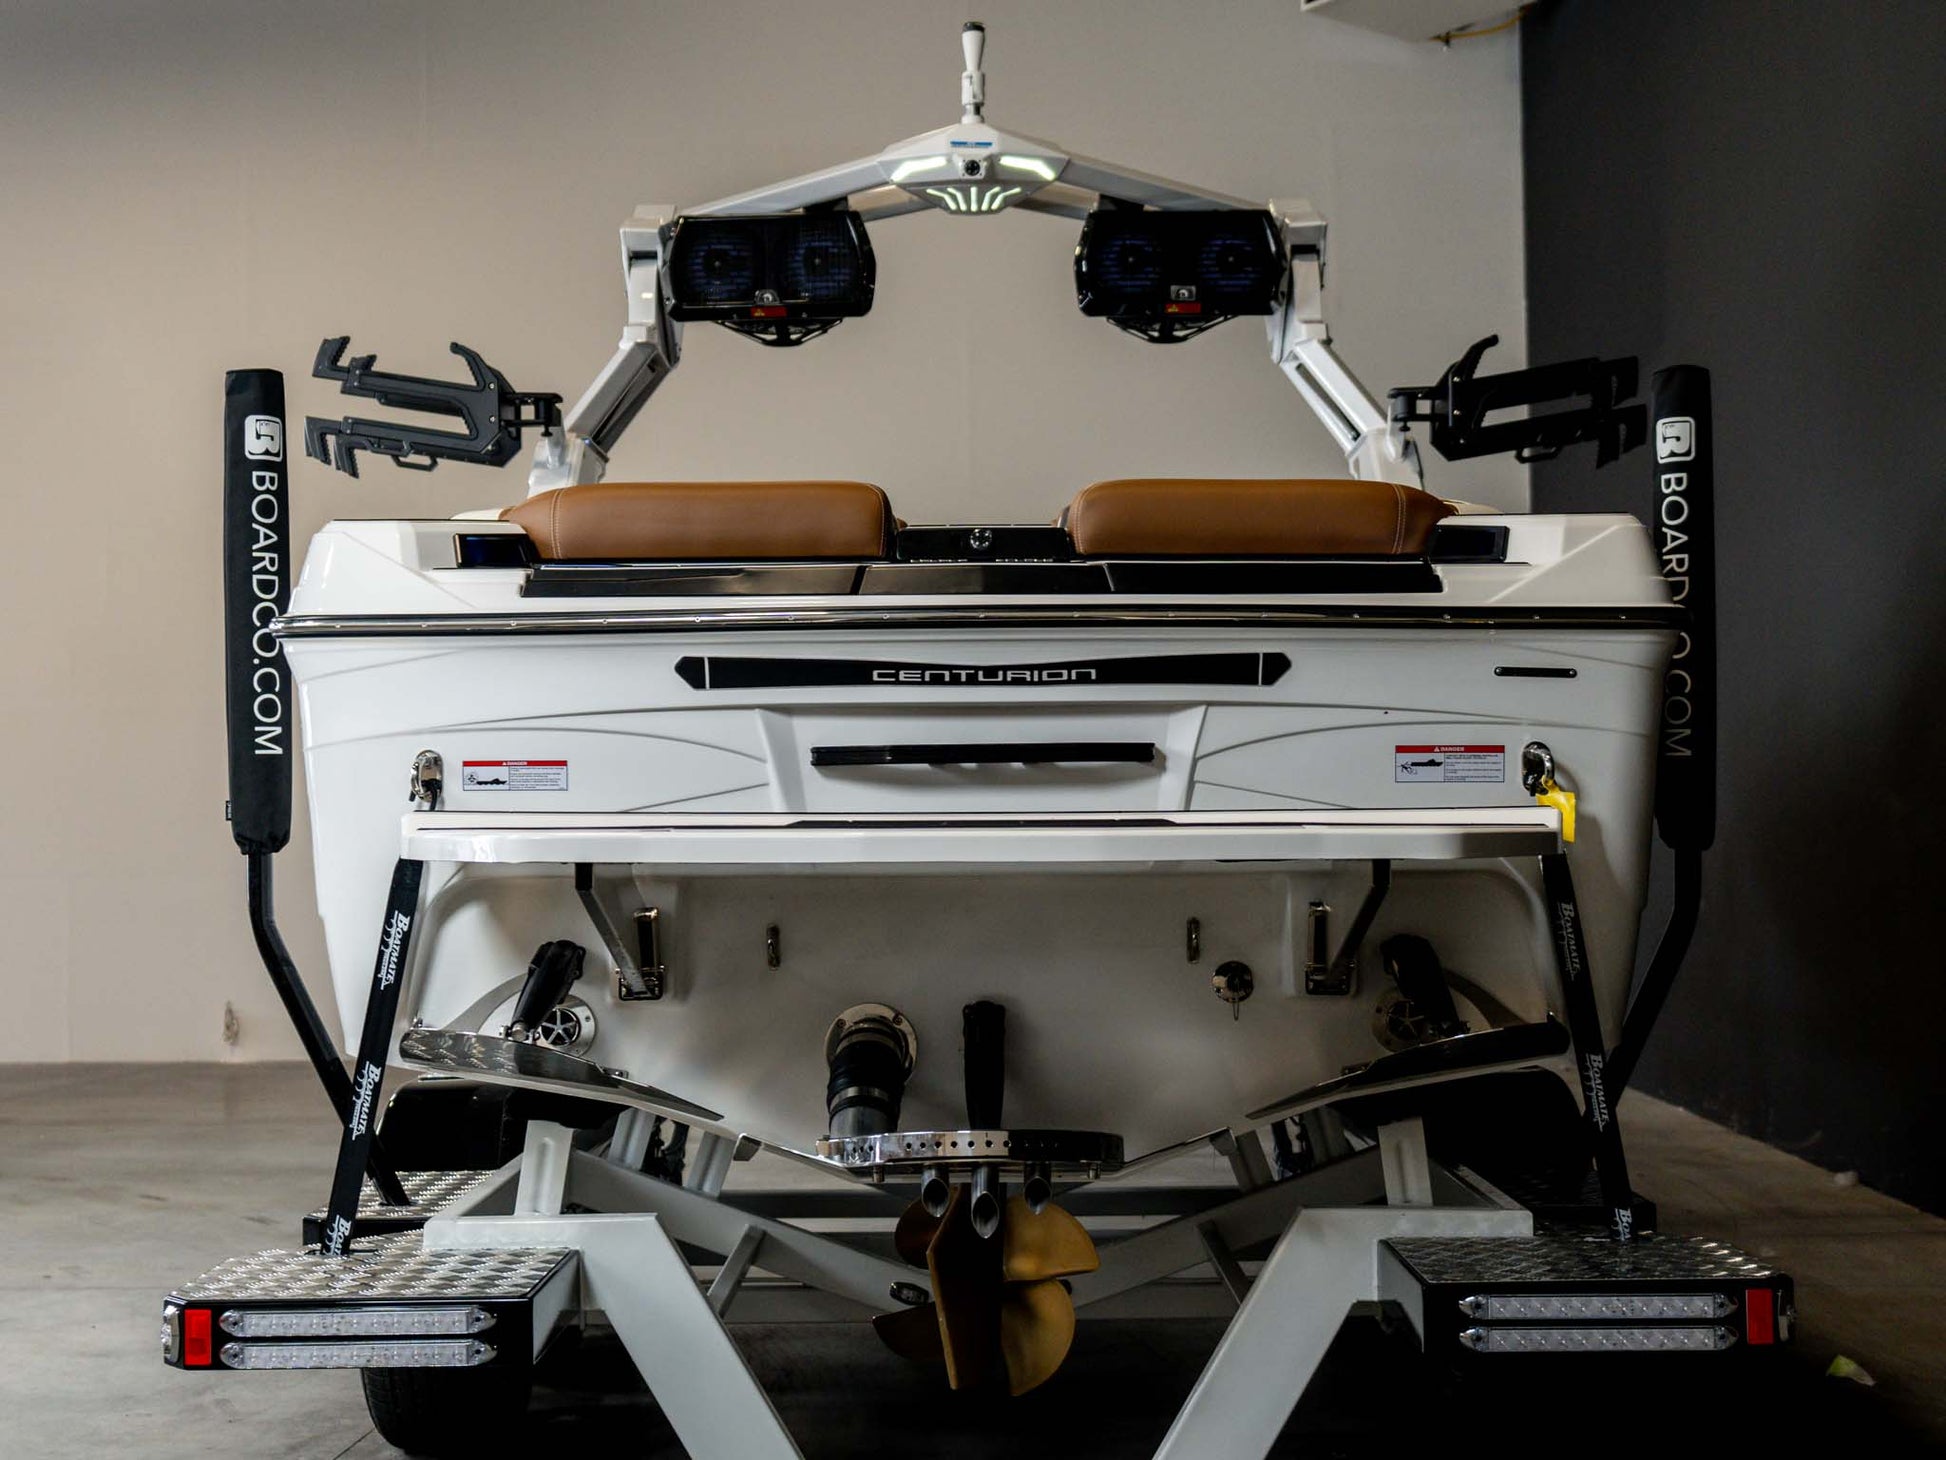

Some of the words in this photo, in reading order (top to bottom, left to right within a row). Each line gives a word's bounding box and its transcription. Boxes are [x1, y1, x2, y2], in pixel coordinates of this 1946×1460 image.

[251, 471, 283, 756] BOARDCO.COM
[872, 668, 1097, 683] CENTURION
[386, 913, 411, 985] BOATMATE
[358, 1063, 382, 1135] BOATMATE
[1590, 1053, 1610, 1126] BOATMATE
